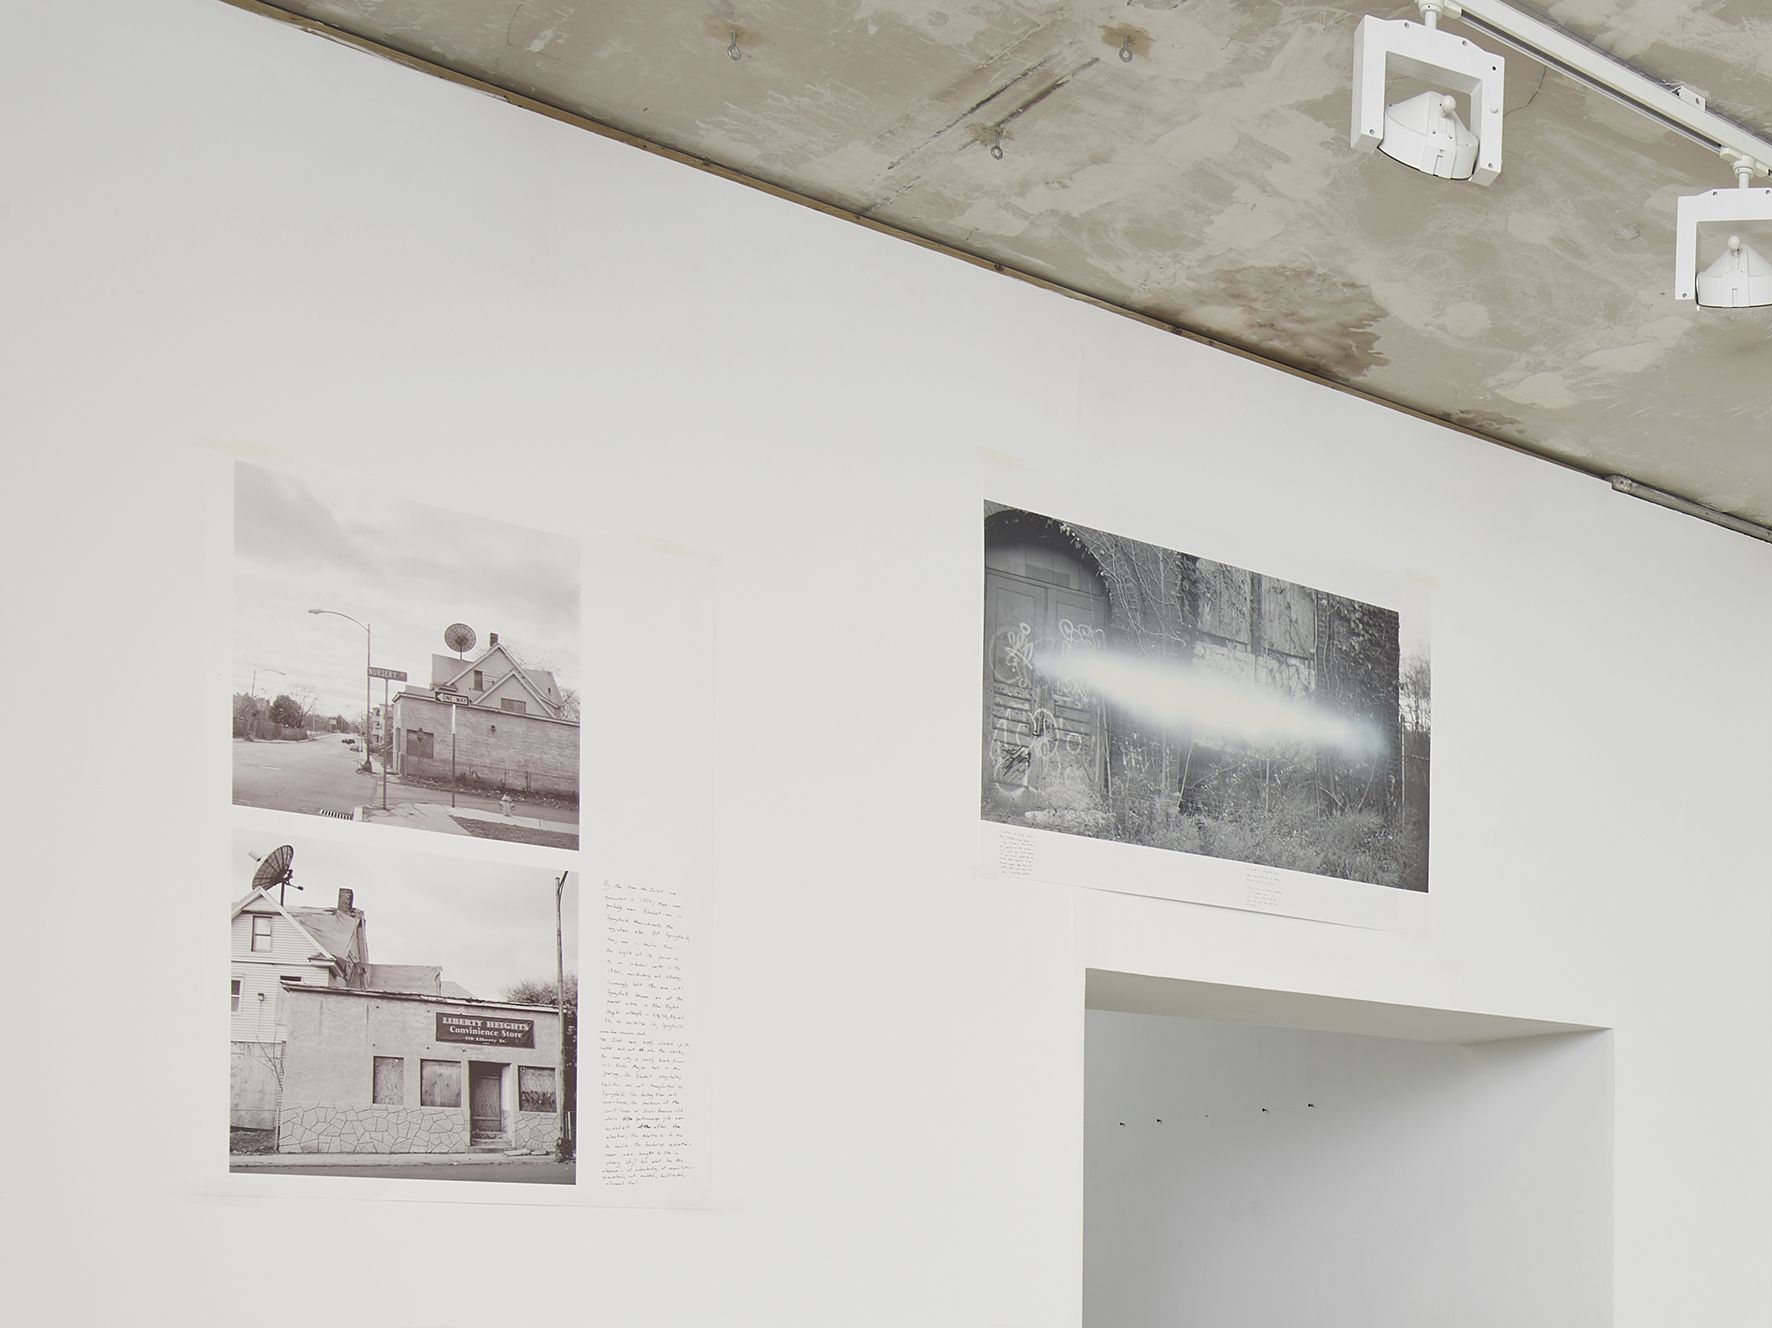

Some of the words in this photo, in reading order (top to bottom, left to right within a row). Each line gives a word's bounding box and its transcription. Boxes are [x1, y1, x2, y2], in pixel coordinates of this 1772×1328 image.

[369, 667, 397, 679] NURSERY
[442, 1016, 484, 1027] LIBERTY
[486, 1020, 530, 1031] HEIGHTS
[449, 1026, 499, 1037] Convinience
[501, 1030, 523, 1038] Store
